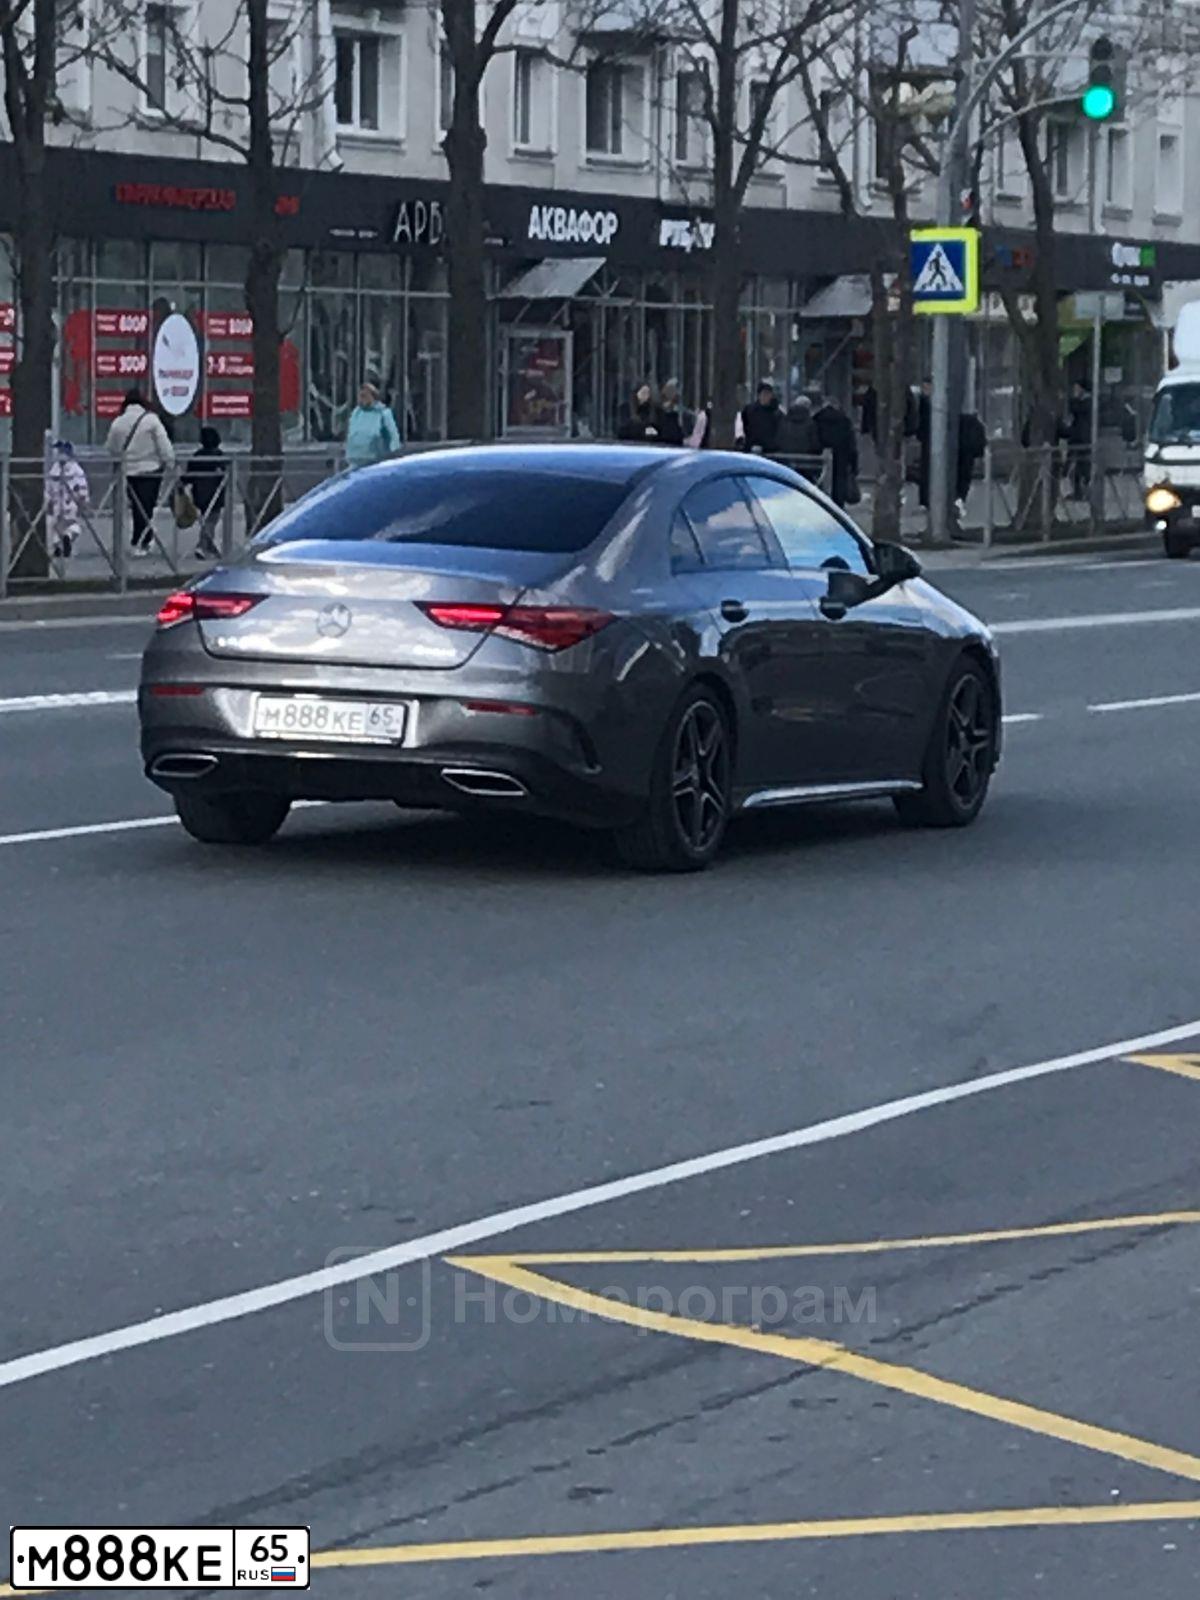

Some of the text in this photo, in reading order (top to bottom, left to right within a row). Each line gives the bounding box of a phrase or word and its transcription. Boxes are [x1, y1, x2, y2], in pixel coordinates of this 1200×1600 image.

[393, 200, 448, 245] АРБ
[528, 205, 618, 244] АКВАФОР
[264, 703, 394, 732] М888КЕ 65
